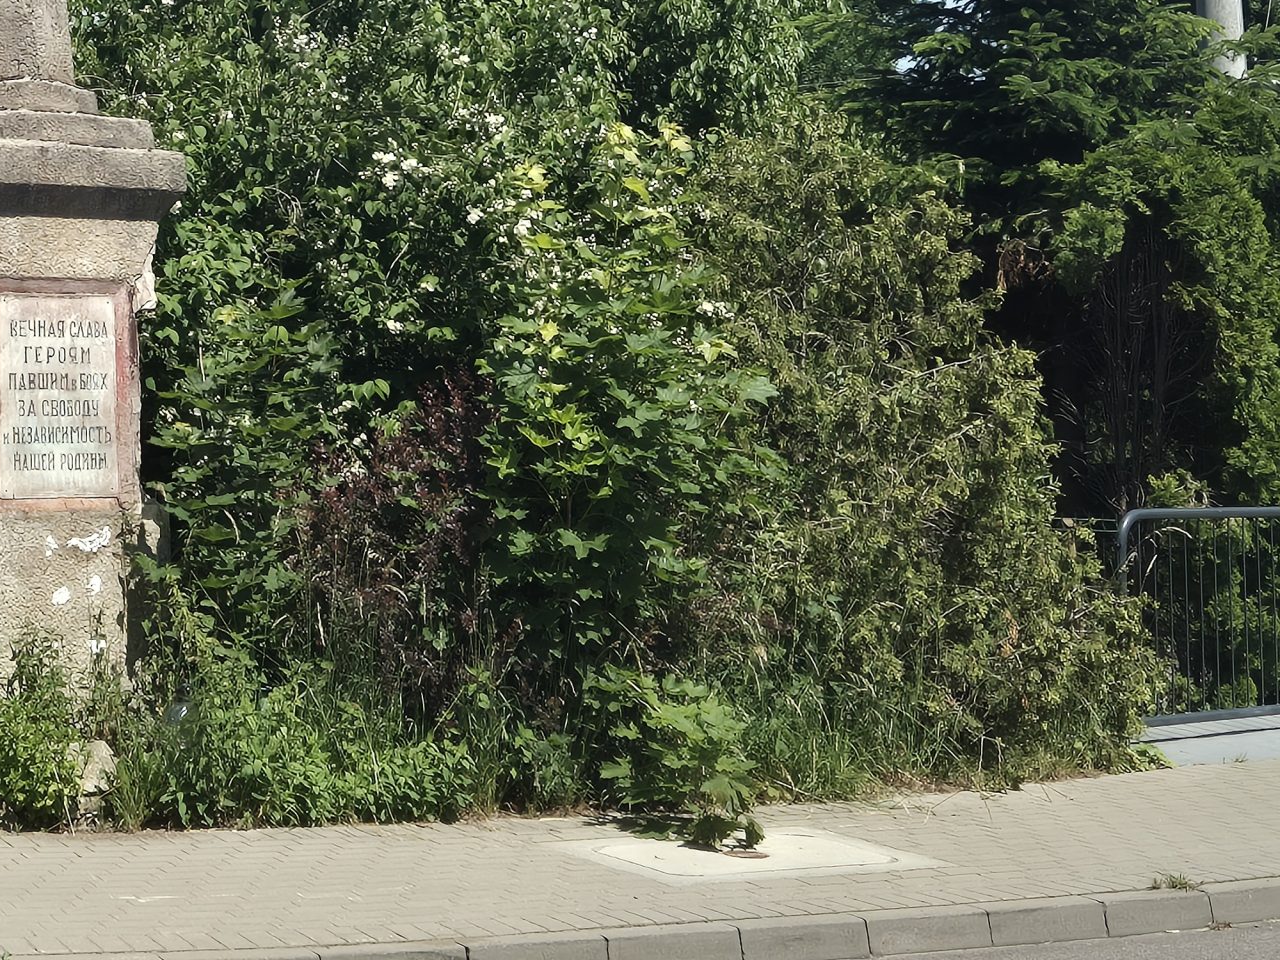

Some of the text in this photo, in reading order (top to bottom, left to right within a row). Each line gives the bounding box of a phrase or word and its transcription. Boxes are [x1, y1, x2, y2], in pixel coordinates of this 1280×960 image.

[10, 320, 108, 338] ВЕЧНАЯ СЛАВА
[24, 346, 91, 364] ГЕРОЯМ
[9, 373, 70, 391] ПАВШИМ
[80, 373, 108, 391] БОЯХ
[18, 400, 99, 417] ЗА СВОБОДУ
[13, 426, 112, 444] НЕЗАВИСИМОСТЬ
[14, 451, 108, 471] НАШЕЙ РОДИНЫ
